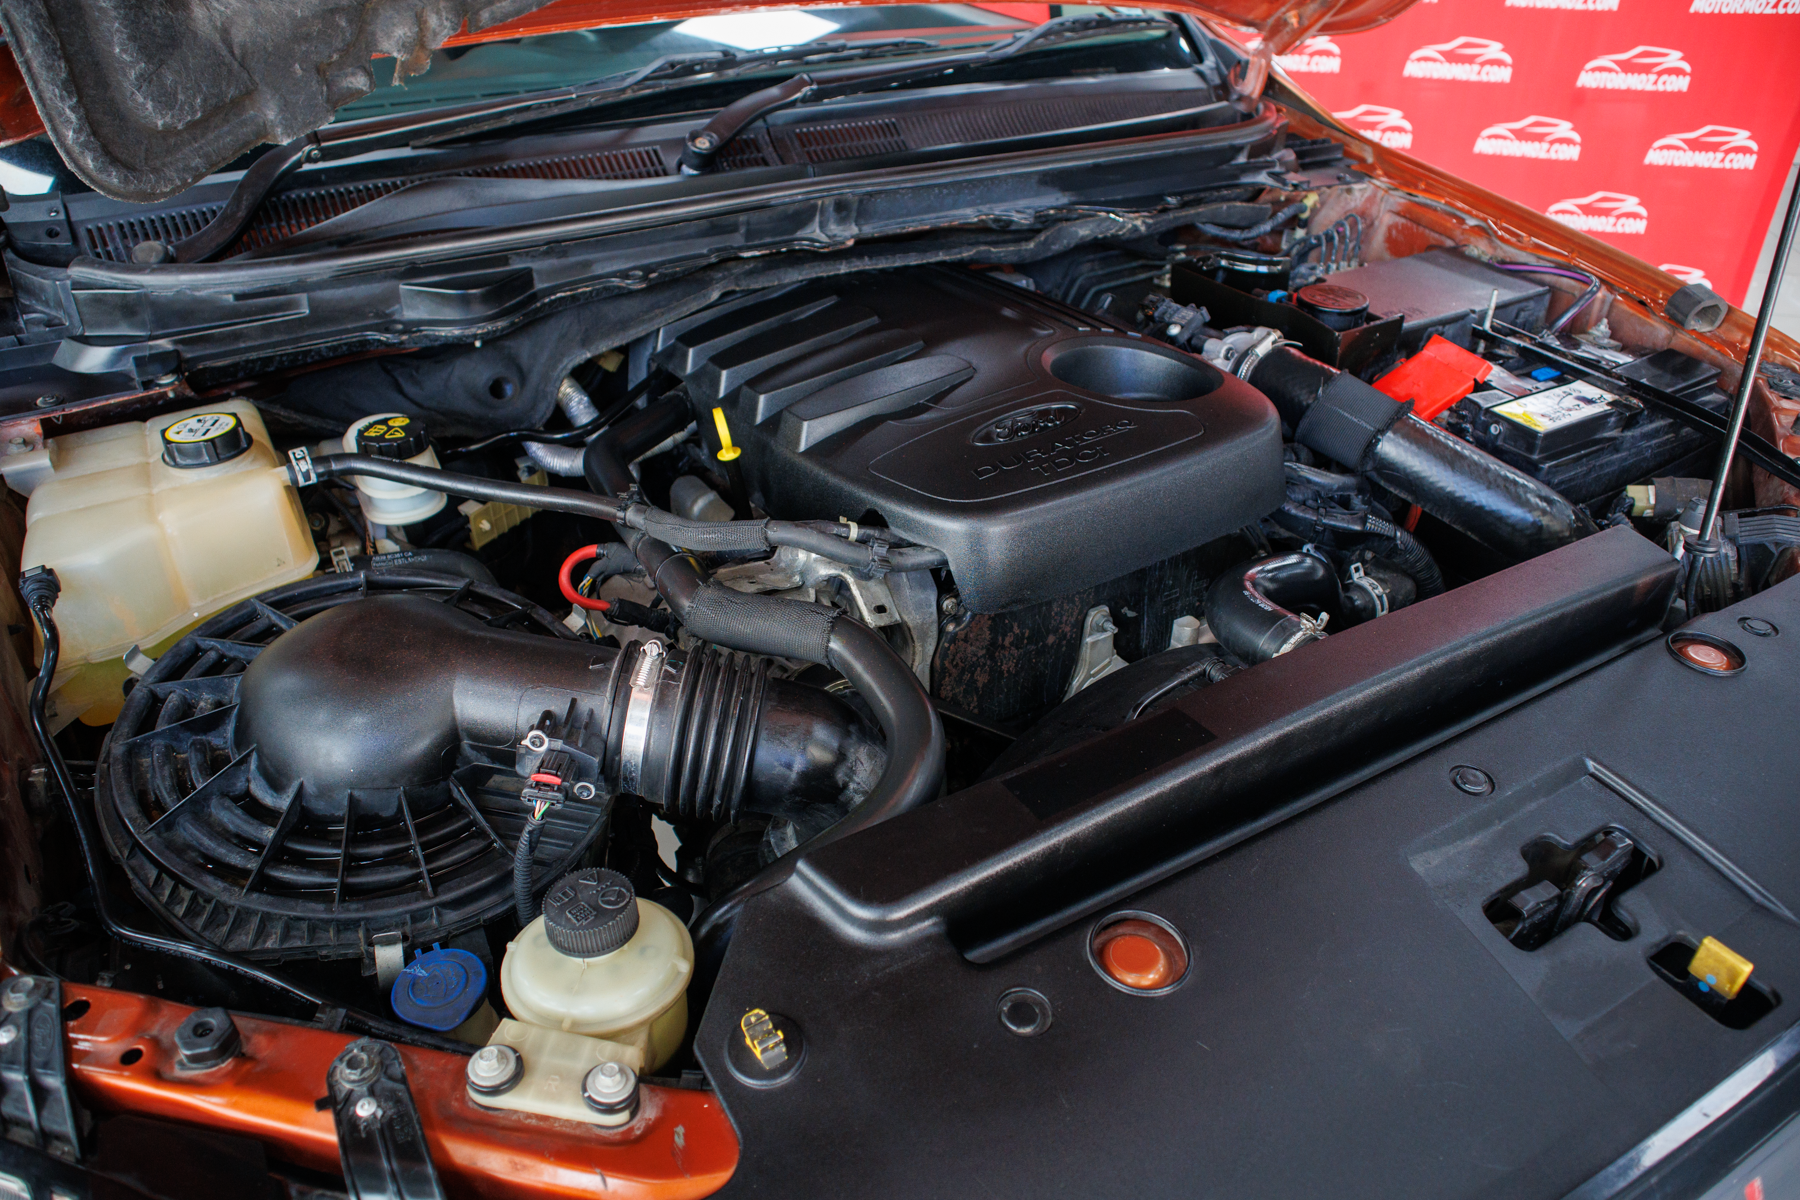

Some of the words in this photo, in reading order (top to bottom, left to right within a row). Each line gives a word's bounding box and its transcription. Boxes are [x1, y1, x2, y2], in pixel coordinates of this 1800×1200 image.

[1402, 60, 1513, 83] MOTORMOZ.COM
[1576, 71, 1691, 92] MOTORMOZ.COM
[1473, 137, 1582, 161] MOTORMOZ.COM
[1643, 148, 1758, 170] MOTORMOZ.COM
[1545, 213, 1648, 234] TORMOZ.COM
[994, 409, 1065, 441] Ford
[971, 419, 1138, 480] DURATORQ
[543, 1074, 561, 1092] R
